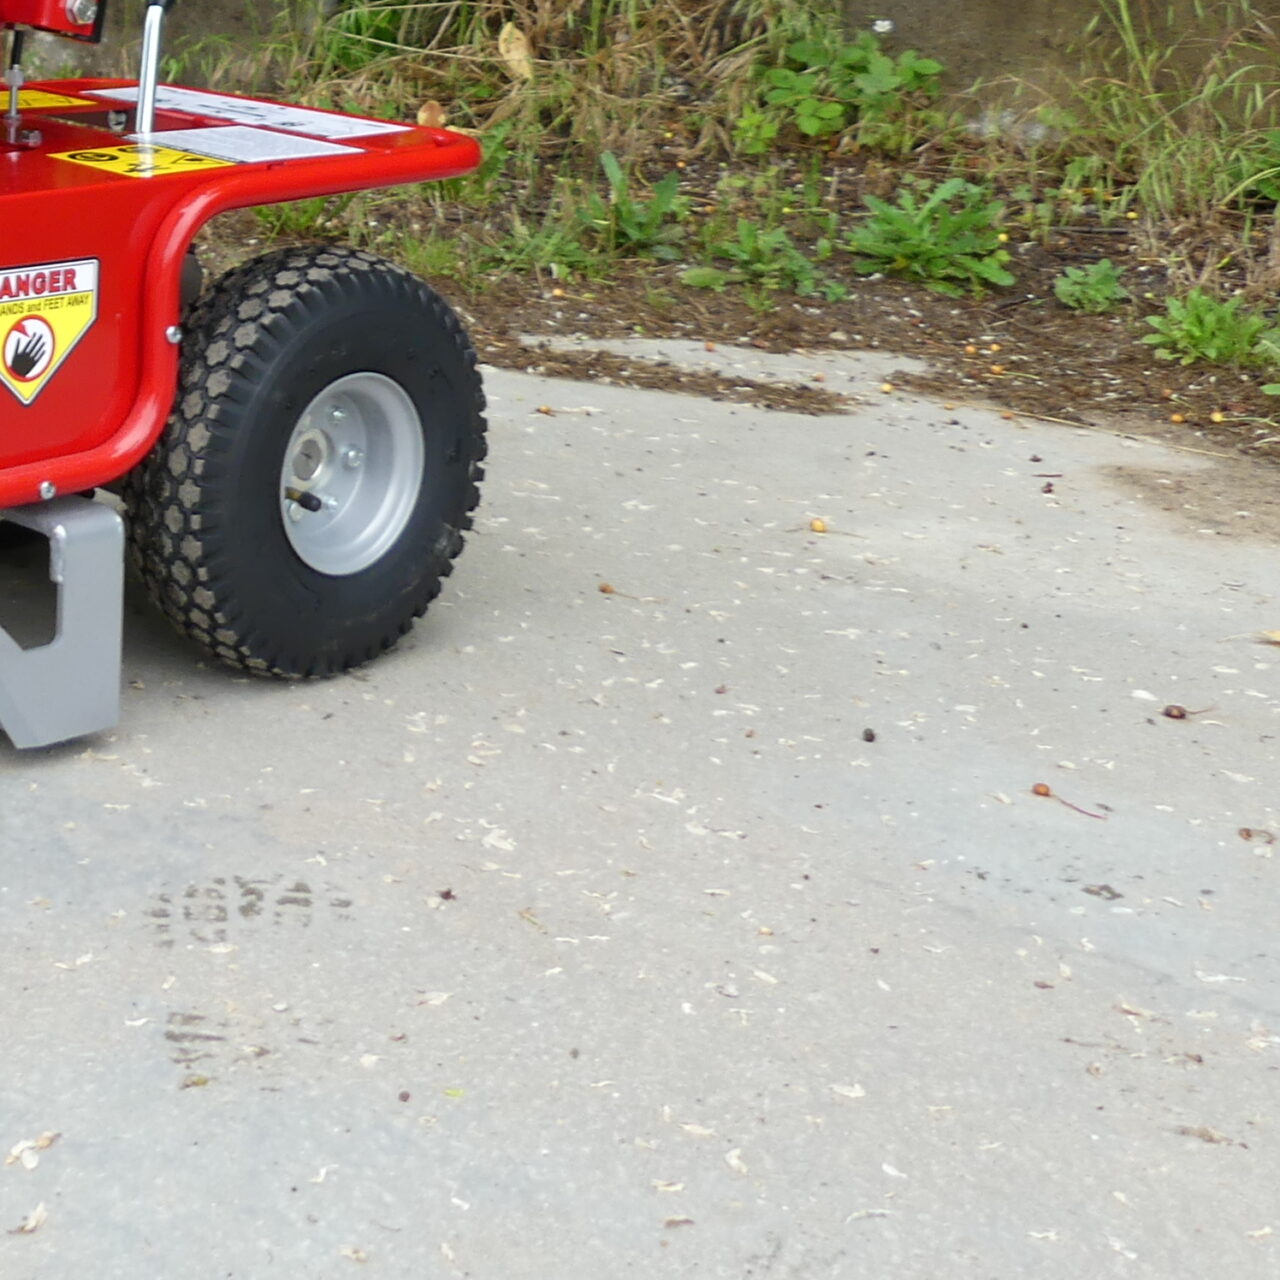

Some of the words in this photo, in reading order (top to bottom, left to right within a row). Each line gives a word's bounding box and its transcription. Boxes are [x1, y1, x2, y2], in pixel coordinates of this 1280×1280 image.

[26, 301, 43, 313] and
[43, 298, 65, 311] FEET
[66, 294, 91, 307] AWAY
